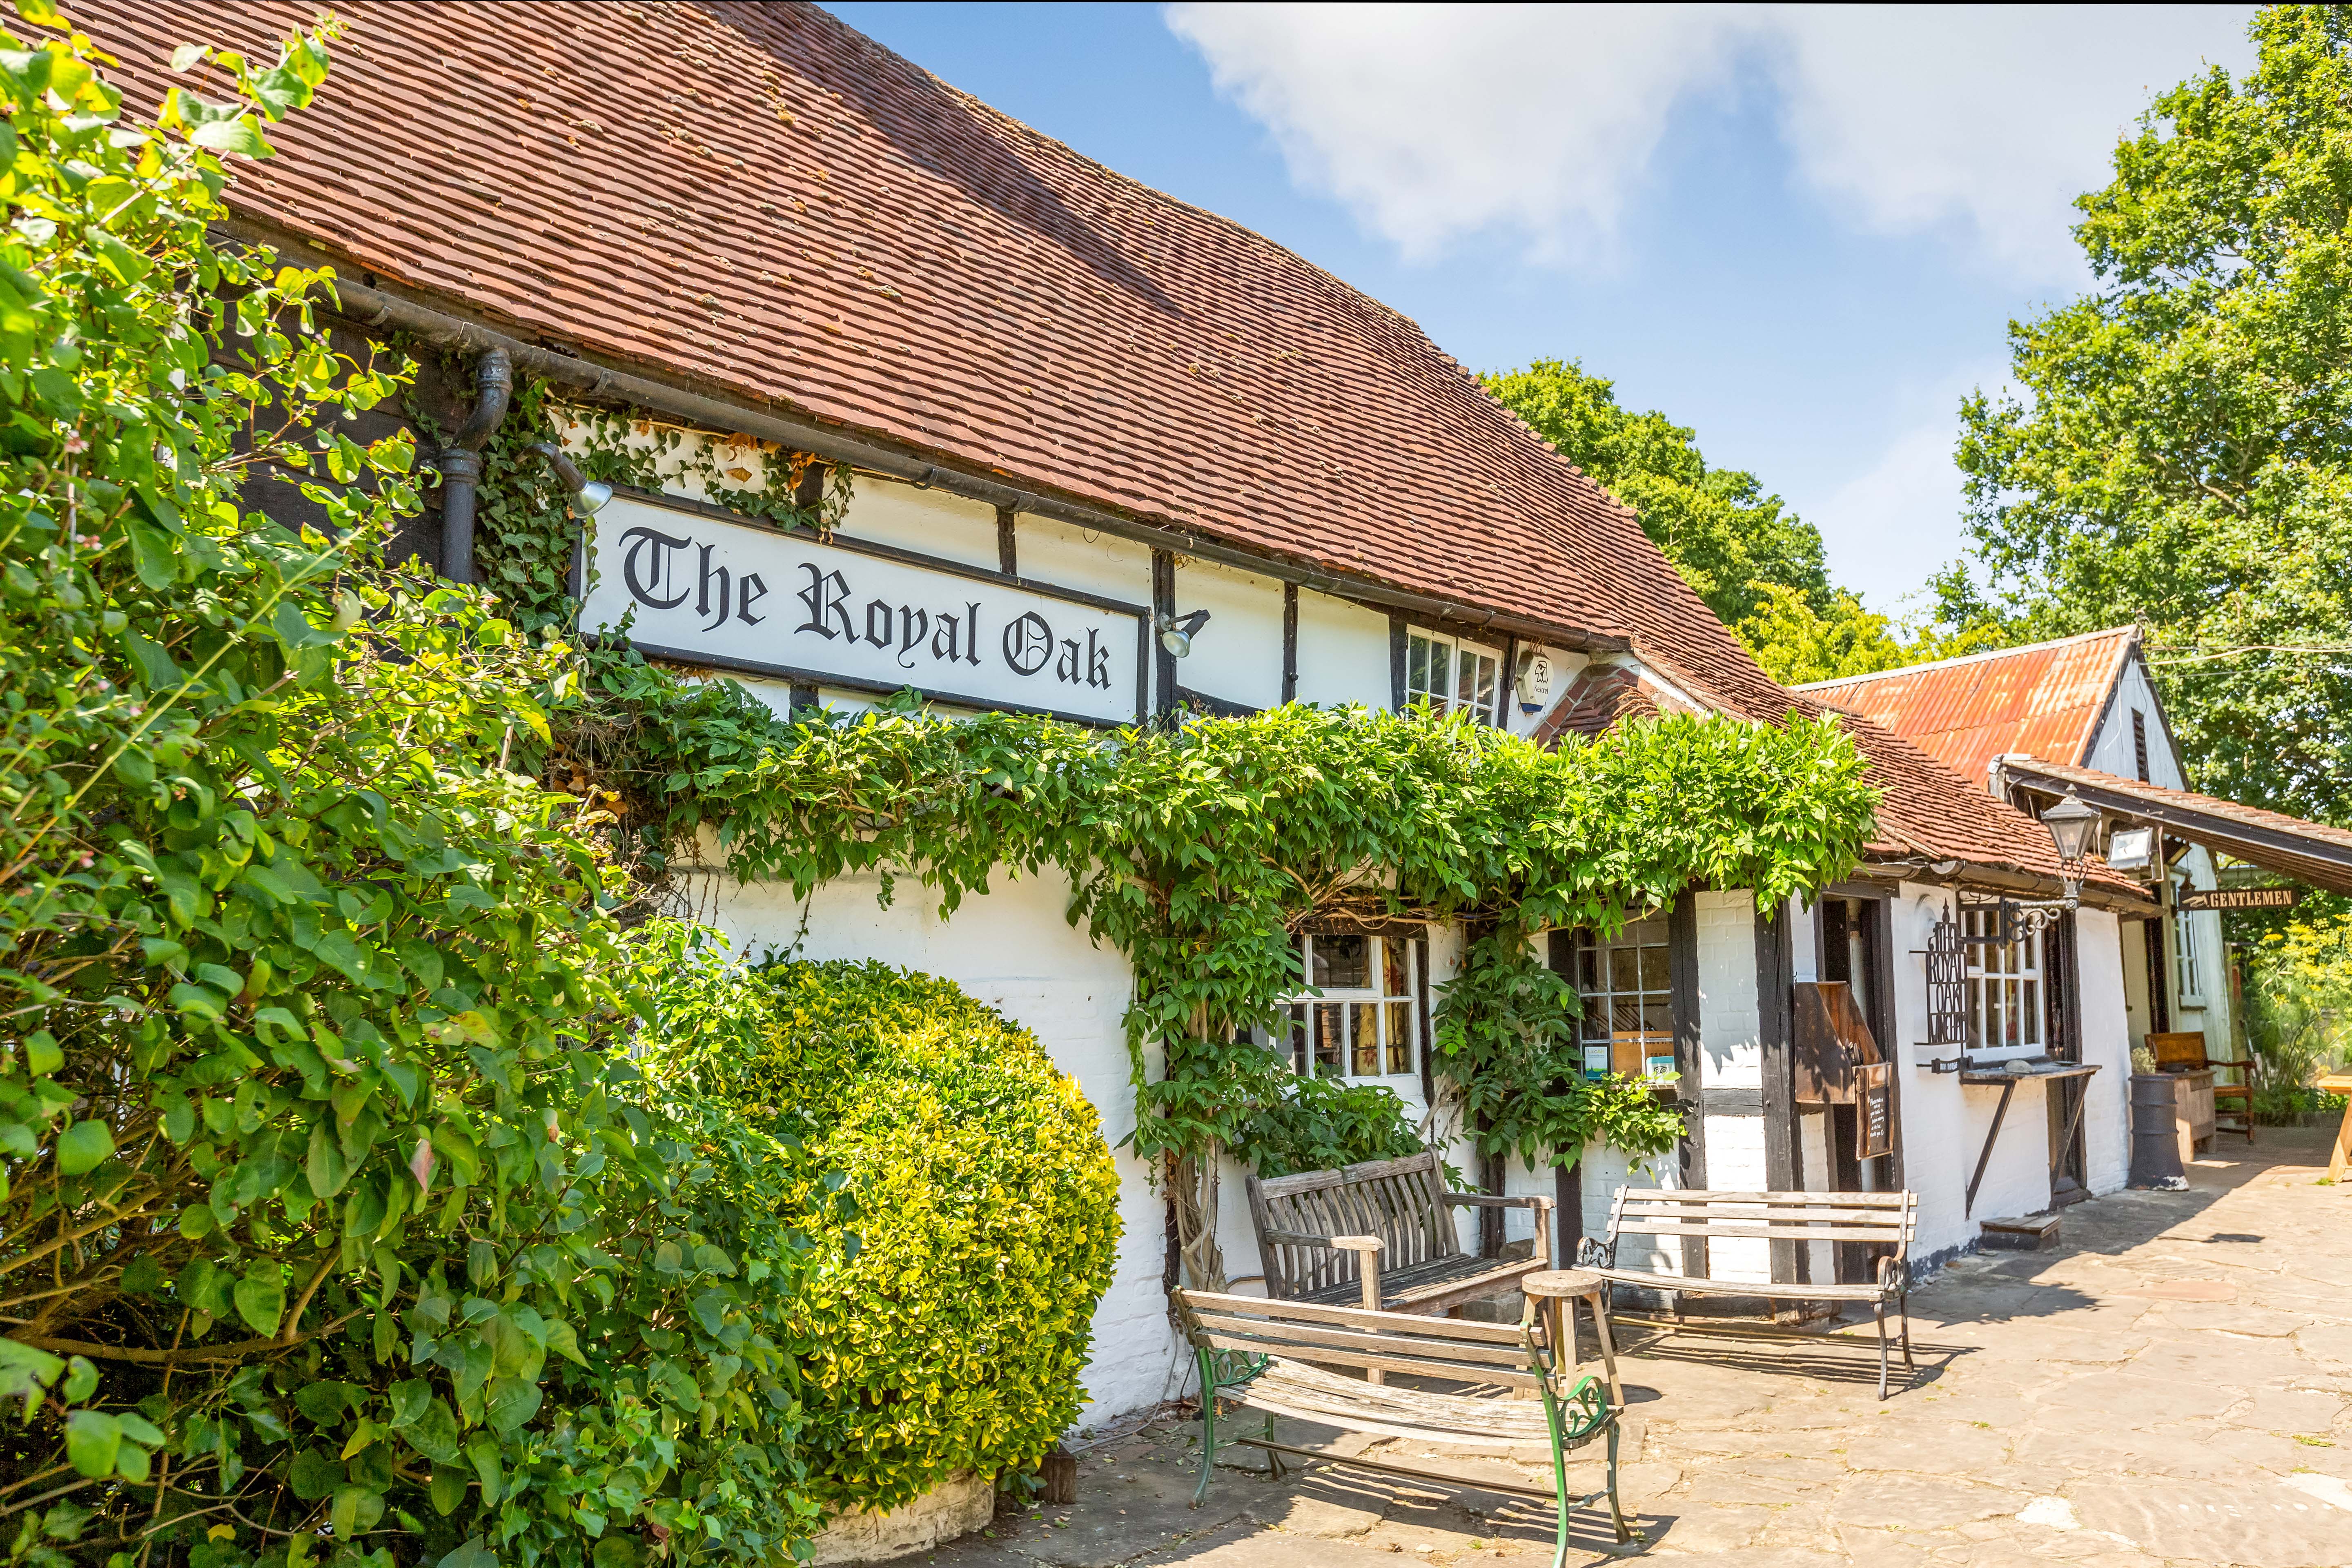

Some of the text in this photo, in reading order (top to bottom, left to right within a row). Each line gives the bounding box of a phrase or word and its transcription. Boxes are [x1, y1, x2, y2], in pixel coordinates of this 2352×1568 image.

[619, 526, 1111, 691] The Royal Oak
[1534, 684, 1548, 695] Kestrel
[2209, 890, 2292, 907] GENTLEMEN
[1936, 923, 1957, 952] THE
[1927, 952, 1967, 984] ROYAL
[1936, 984, 1961, 1013] OAK
